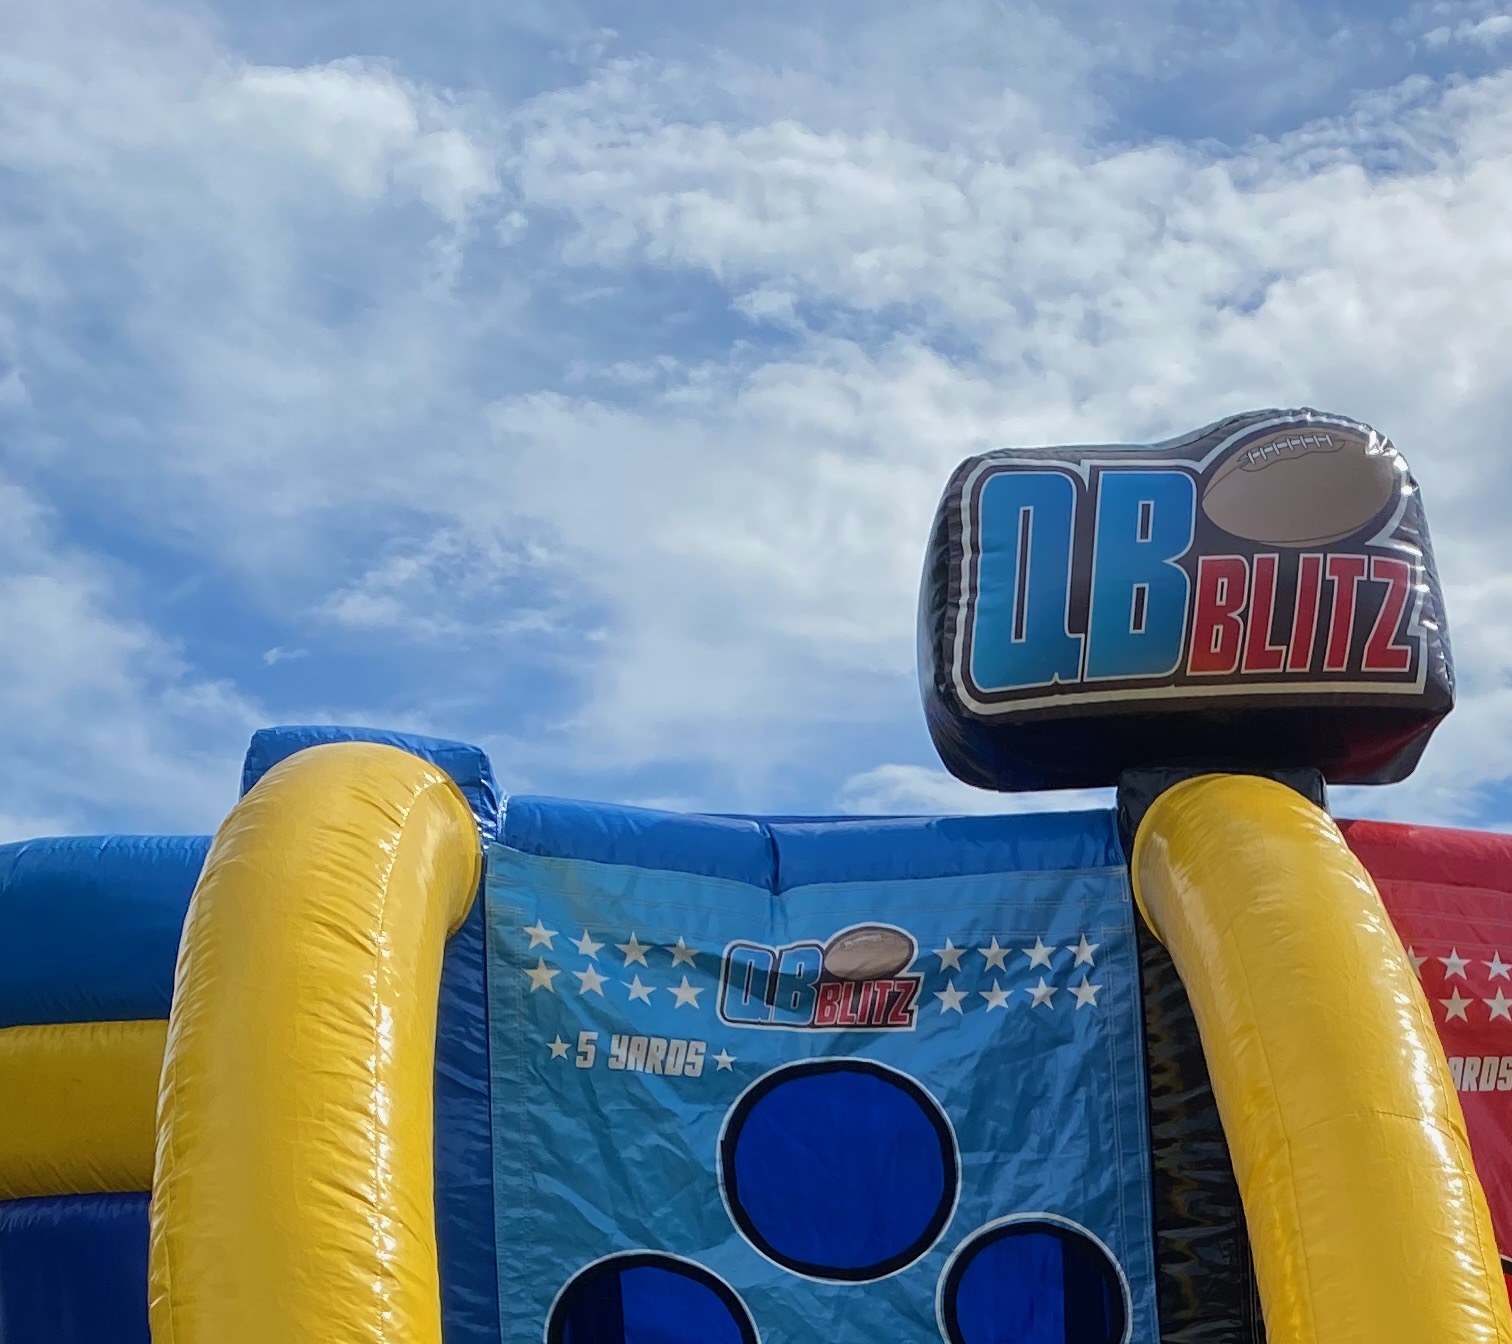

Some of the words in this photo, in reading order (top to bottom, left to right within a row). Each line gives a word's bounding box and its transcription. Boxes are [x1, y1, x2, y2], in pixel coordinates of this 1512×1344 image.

[969, 470, 1198, 693] QB
[1186, 553, 1412, 677] BLITZ
[724, 946, 823, 1025] QB
[814, 980, 916, 1025] BLITZ
[575, 1031, 598, 1068] 5
[608, 1034, 707, 1077] YARDS
